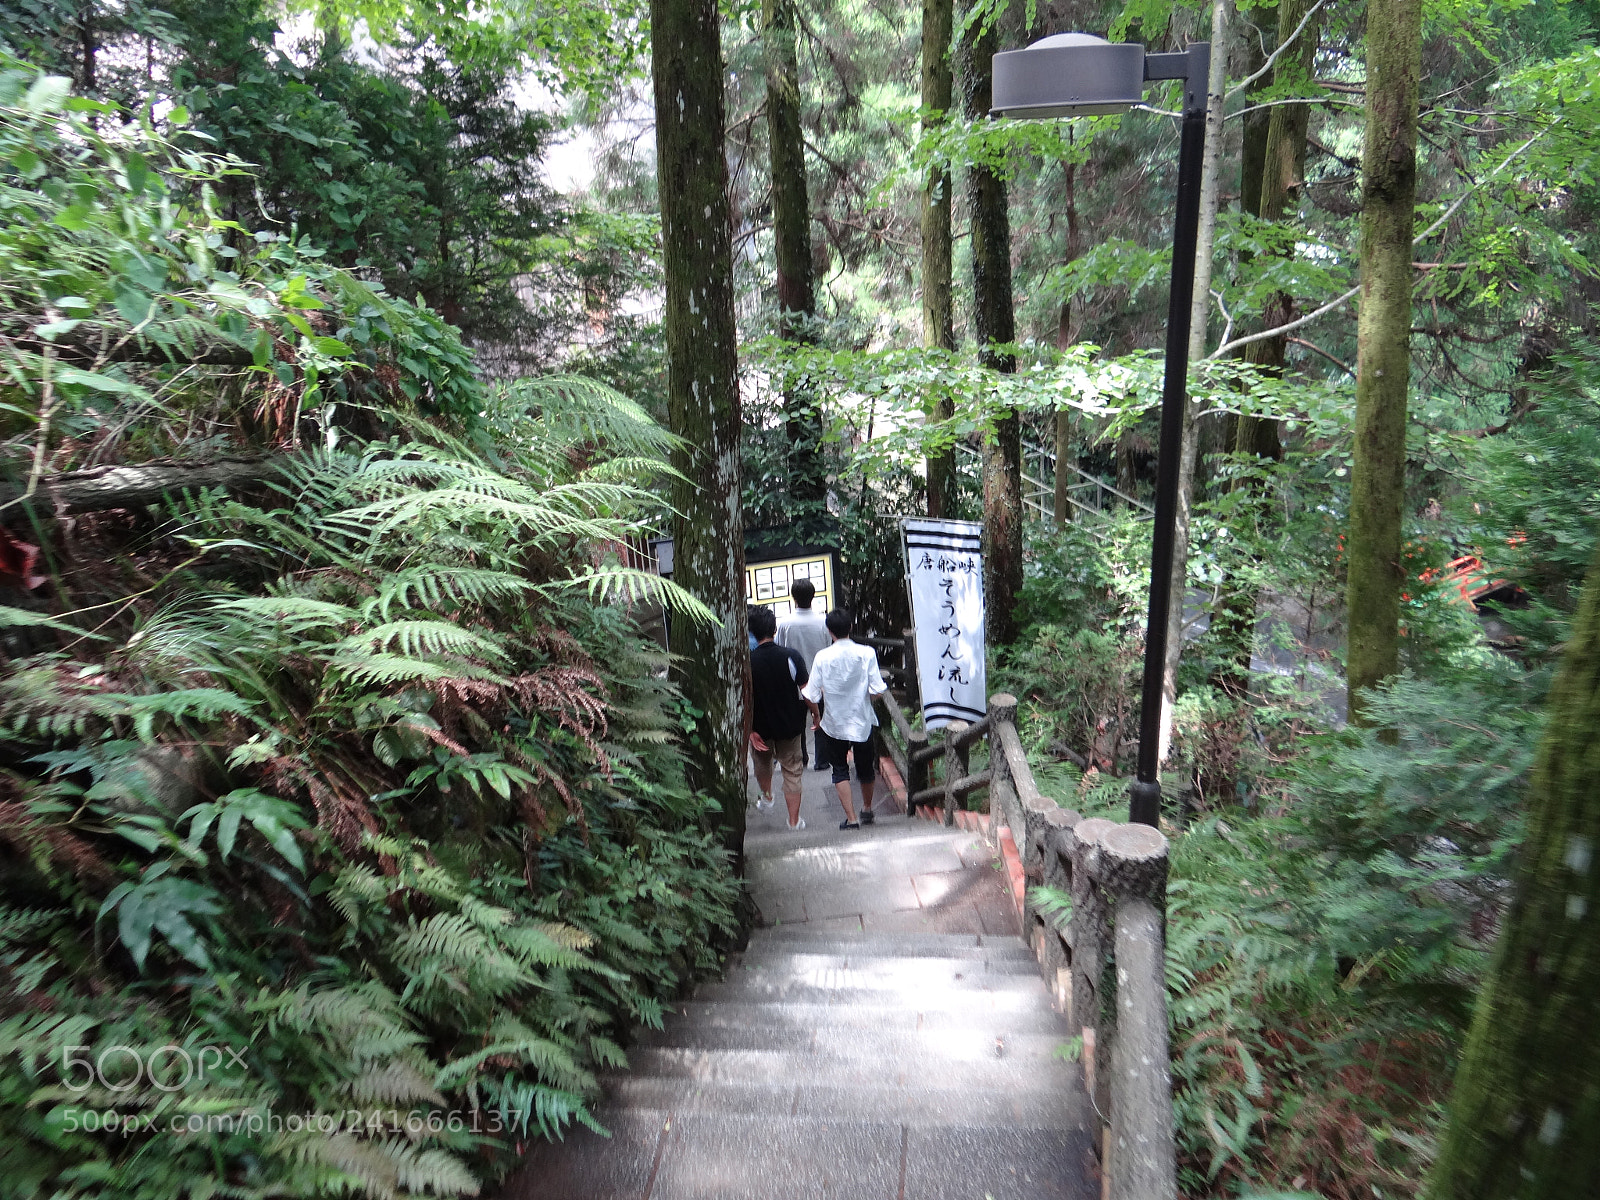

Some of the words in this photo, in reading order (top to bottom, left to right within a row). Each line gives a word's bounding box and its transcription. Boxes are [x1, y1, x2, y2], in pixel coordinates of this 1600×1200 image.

[916, 553, 978, 576] 唐船峡
[938, 578, 969, 704] そうめん流し
